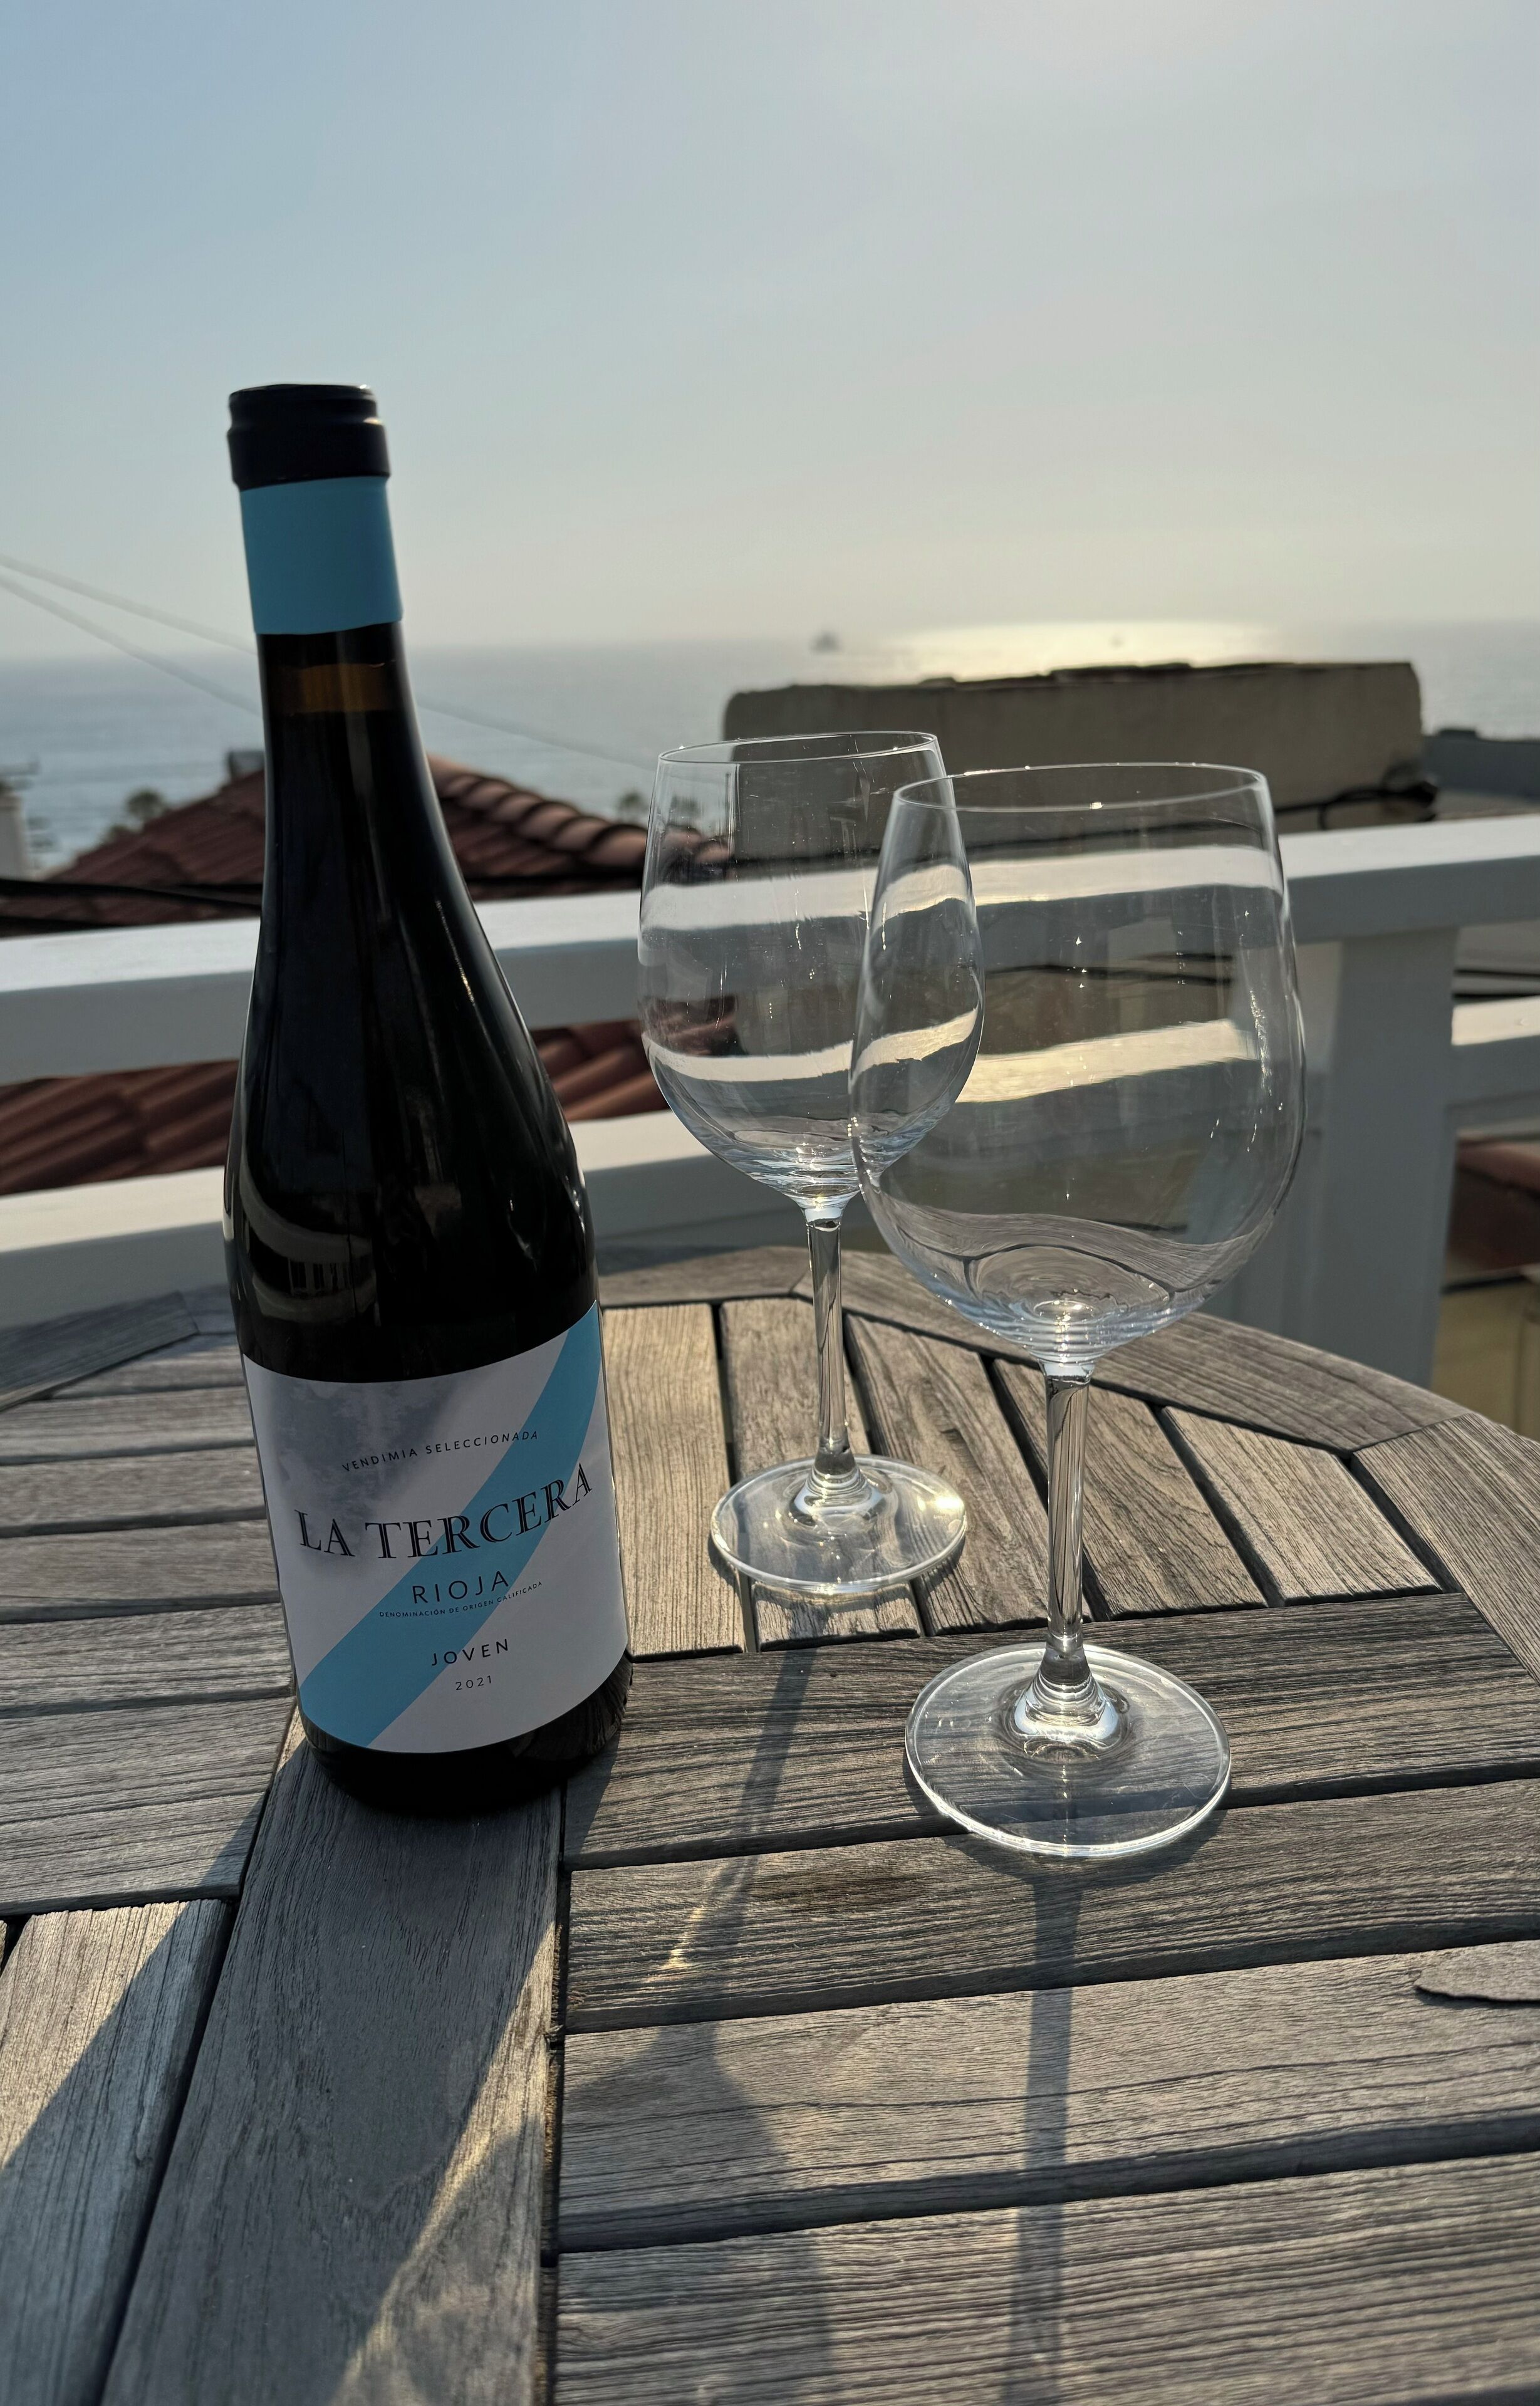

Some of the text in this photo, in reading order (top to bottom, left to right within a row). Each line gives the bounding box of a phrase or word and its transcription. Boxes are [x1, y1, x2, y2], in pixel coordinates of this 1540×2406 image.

[342, 1430, 538, 1472] VENDIMIA SELECCIONADA
[293, 1462, 593, 1559] LA TERCERA
[379, 1608, 445, 1617] DENOMINACIÓN
[462, 1599, 494, 1610] ORIGEN
[497, 1581, 543, 1603] CALIFICADA
[412, 1570, 509, 1604] RIOJA
[432, 1638, 509, 1666] JOVEN
[455, 1675, 492, 1690] 2021
